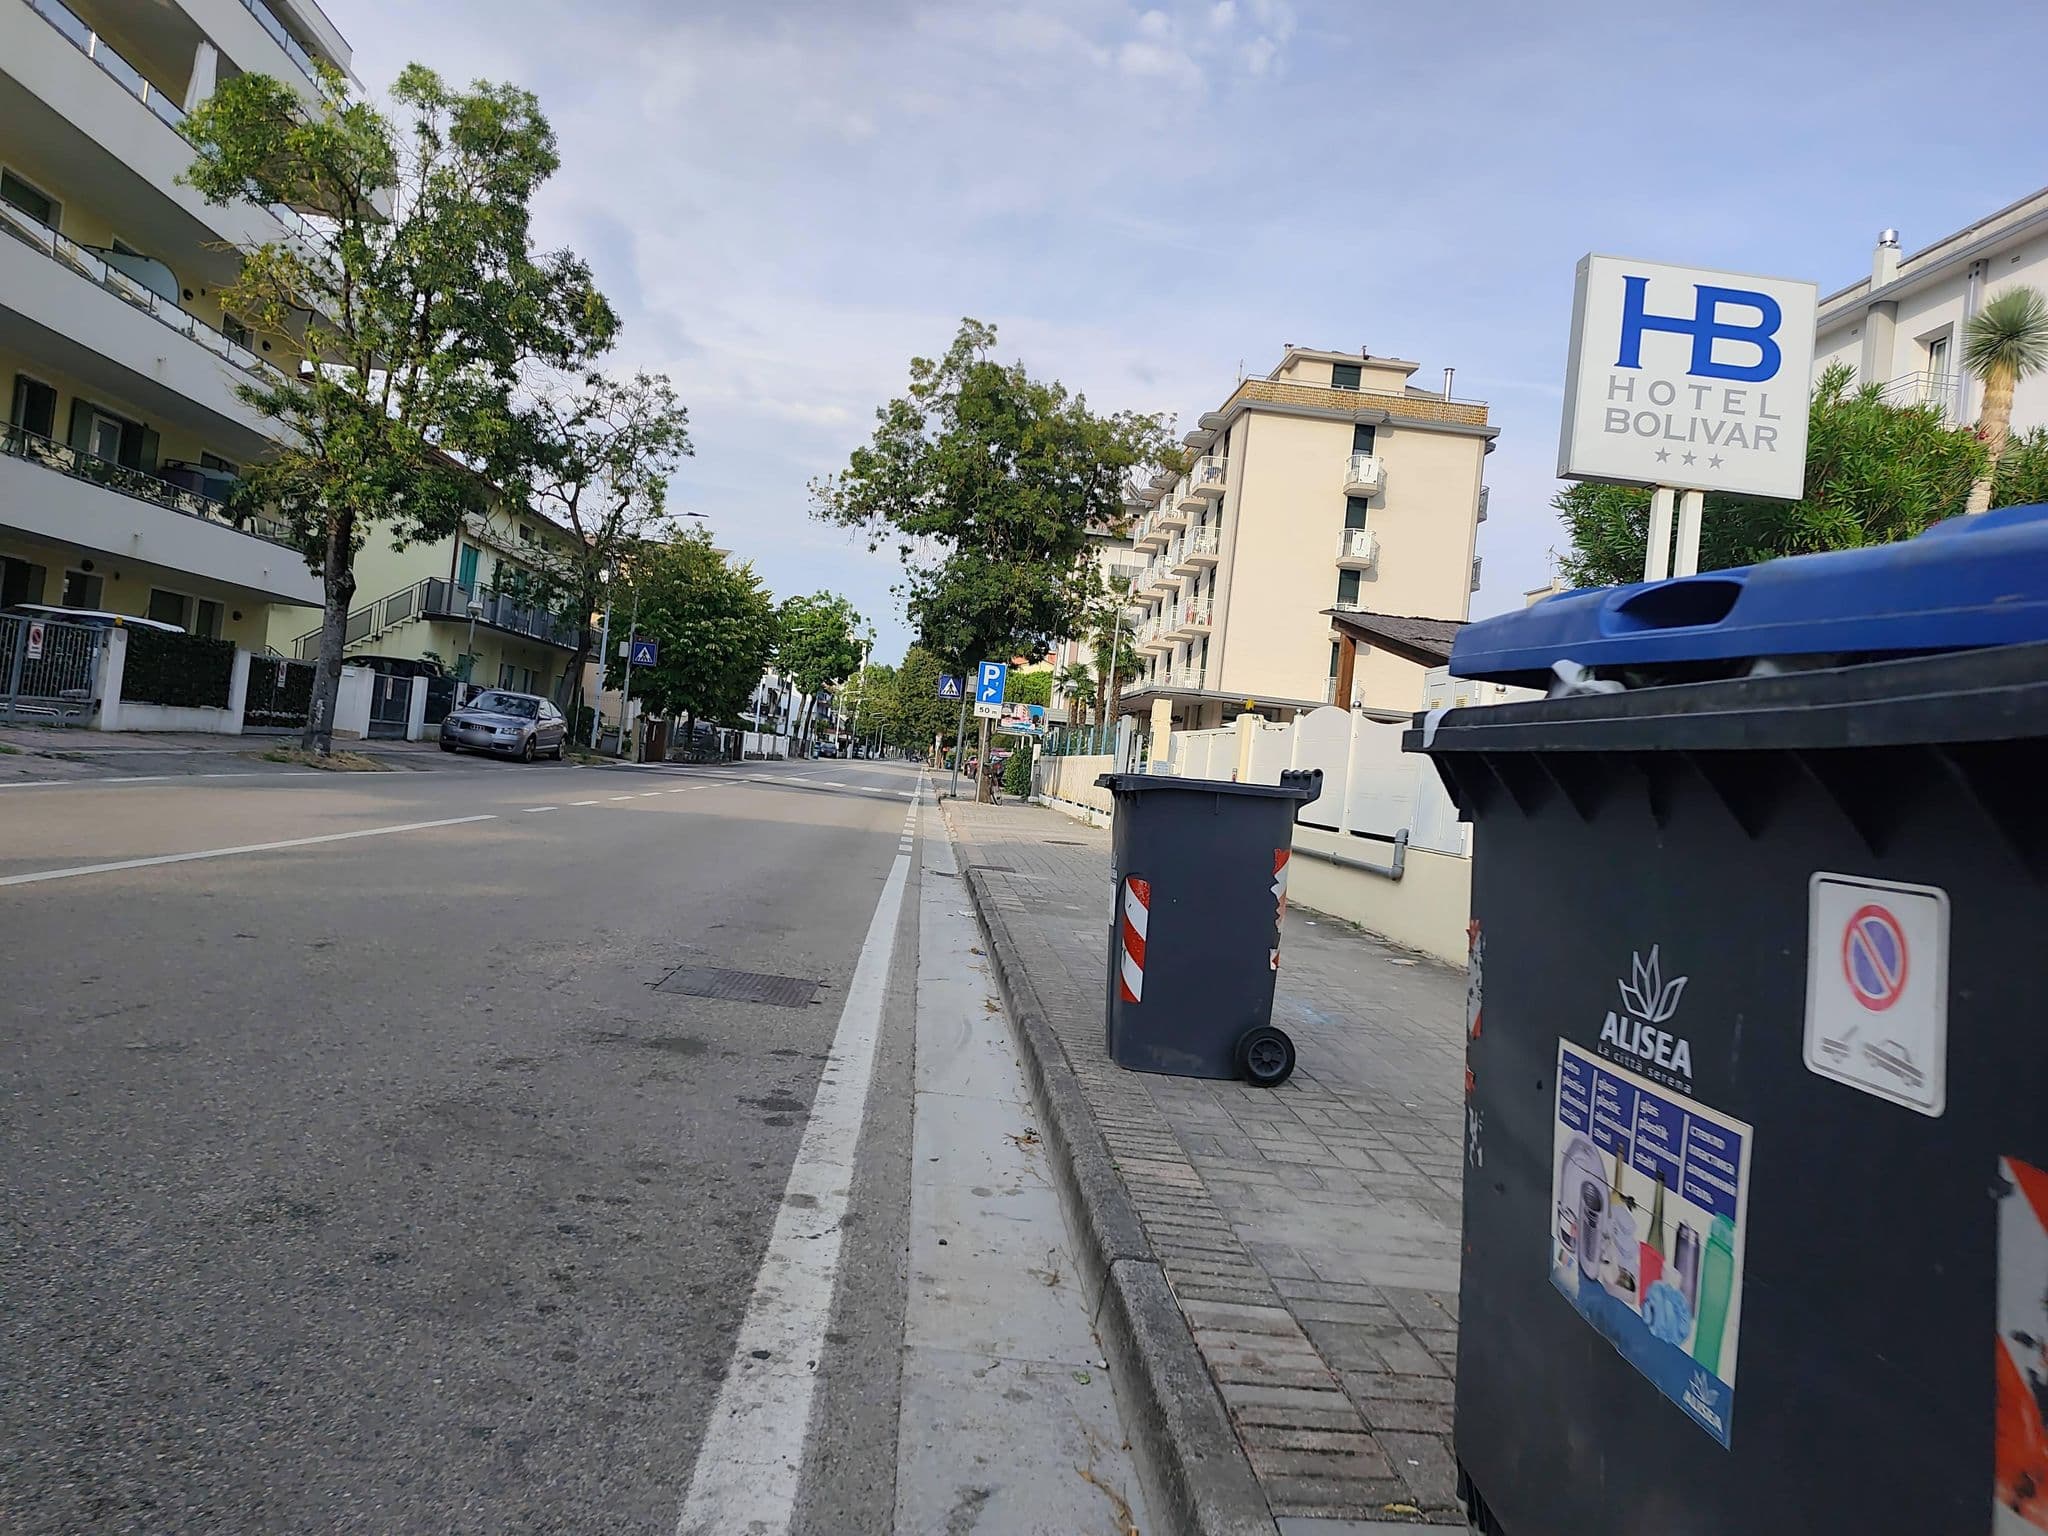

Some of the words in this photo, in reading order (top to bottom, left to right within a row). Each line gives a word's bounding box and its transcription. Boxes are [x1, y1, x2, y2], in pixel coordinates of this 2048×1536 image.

[1613, 274, 1783, 383] HB
[1607, 374, 1782, 421] HOTEL
[1603, 407, 1779, 453] BOLIVAR
[983, 664, 1001, 686] P
[979, 706, 990, 714] 50
[1600, 1010, 1693, 1079] ALISEA
[1646, 1066, 1692, 1095] serena
